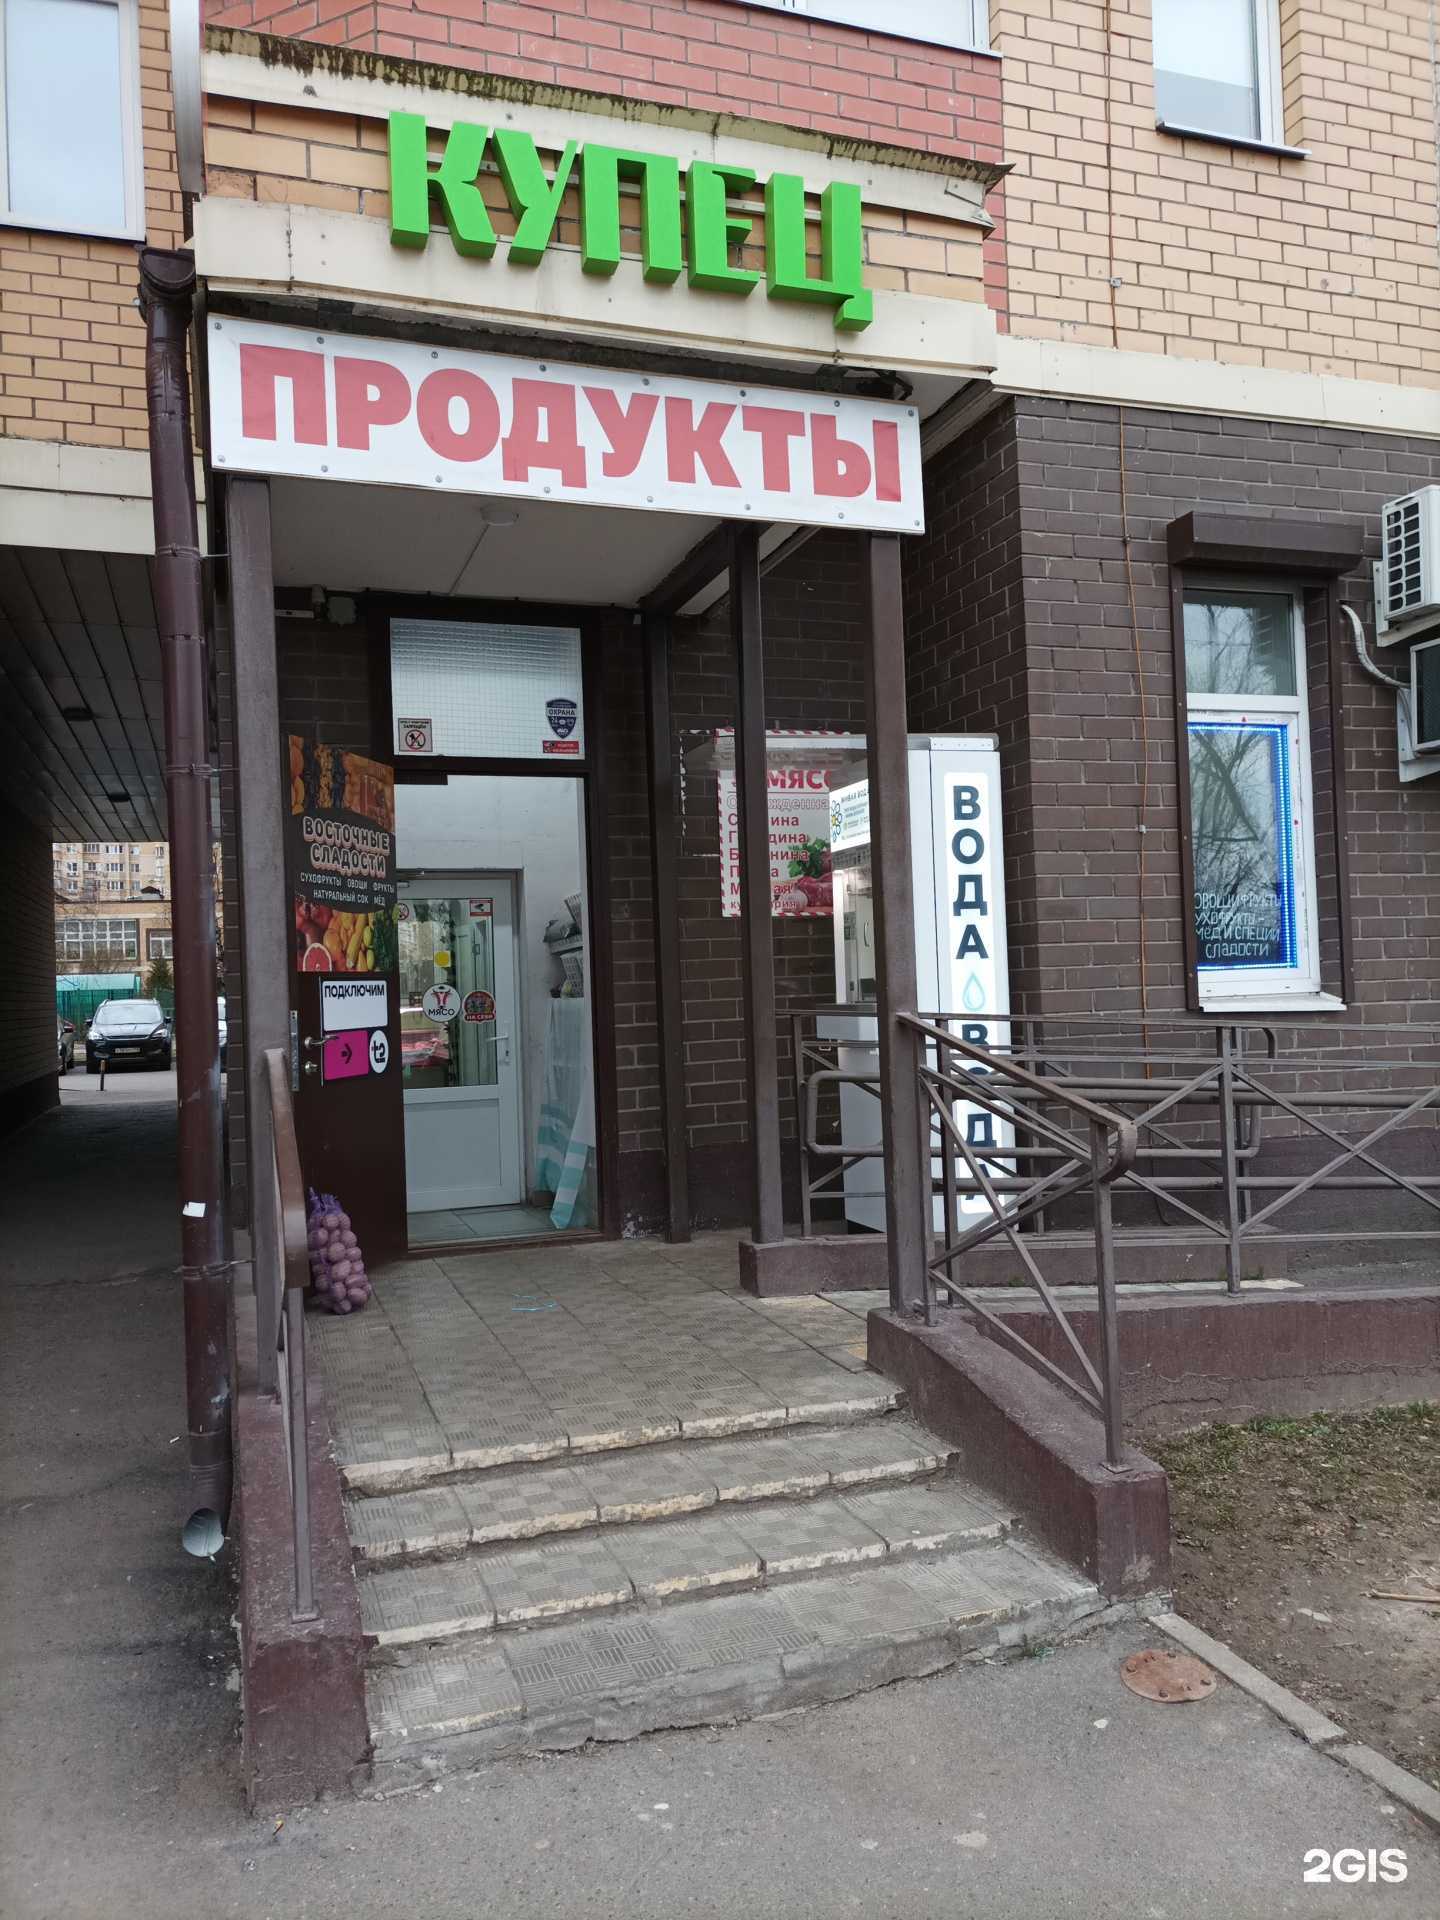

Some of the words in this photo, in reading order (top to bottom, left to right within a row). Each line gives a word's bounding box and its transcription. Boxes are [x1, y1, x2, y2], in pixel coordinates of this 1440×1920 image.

[388, 111, 873, 331] КУПЕЦ
[239, 342, 902, 502] ПРОДУКТЫ
[548, 708, 576, 716] ОХРАНА
[303, 816, 390, 854] ВОСТОЧНЫЕ
[311, 843, 387, 876] СЛАДОСТИ
[951, 784, 989, 961] ВОДА
[300, 872, 341, 886] СУХОФРУКТЫ
[324, 983, 385, 998] ПОДКЛЮЧИМ
[428, 1008, 455, 1016] МЯСО
